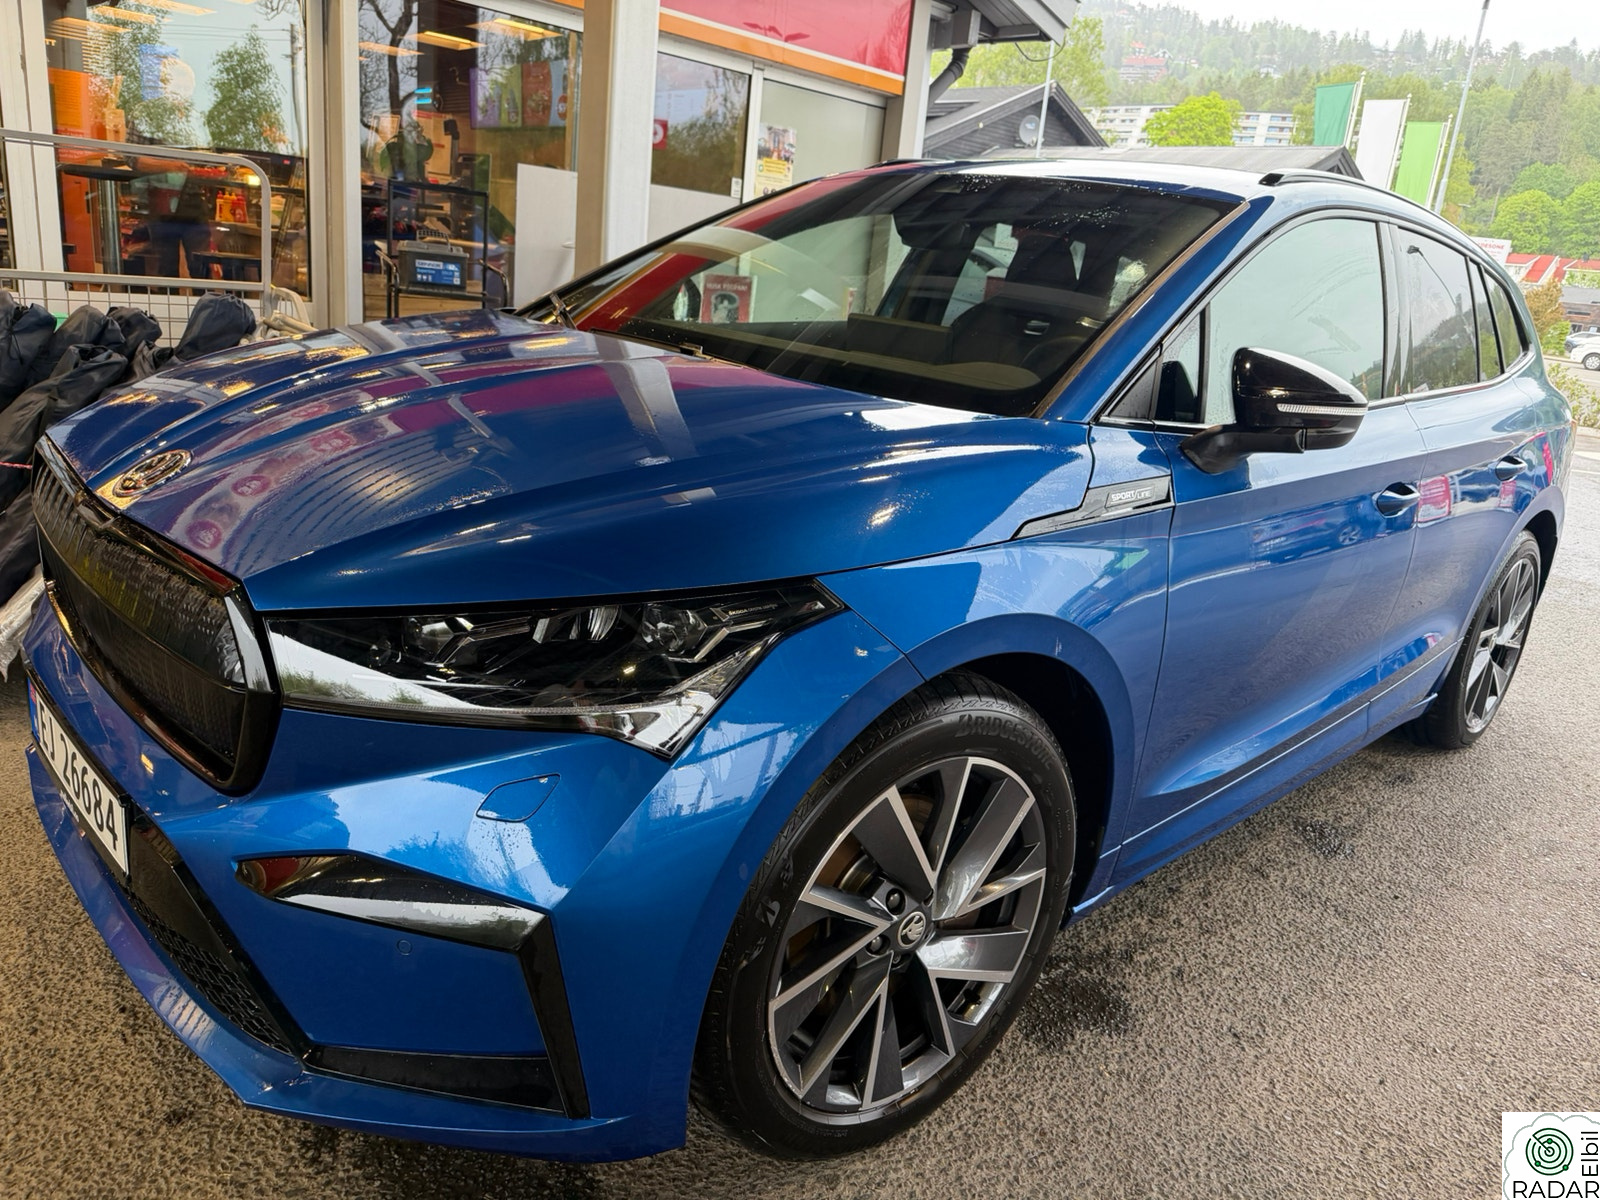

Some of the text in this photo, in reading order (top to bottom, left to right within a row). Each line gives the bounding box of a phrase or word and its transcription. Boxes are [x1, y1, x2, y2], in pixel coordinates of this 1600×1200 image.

[39, 700, 55, 762] EJ
[60, 733, 119, 852] 26684
[955, 713, 1057, 771] BRIDGESTONE
